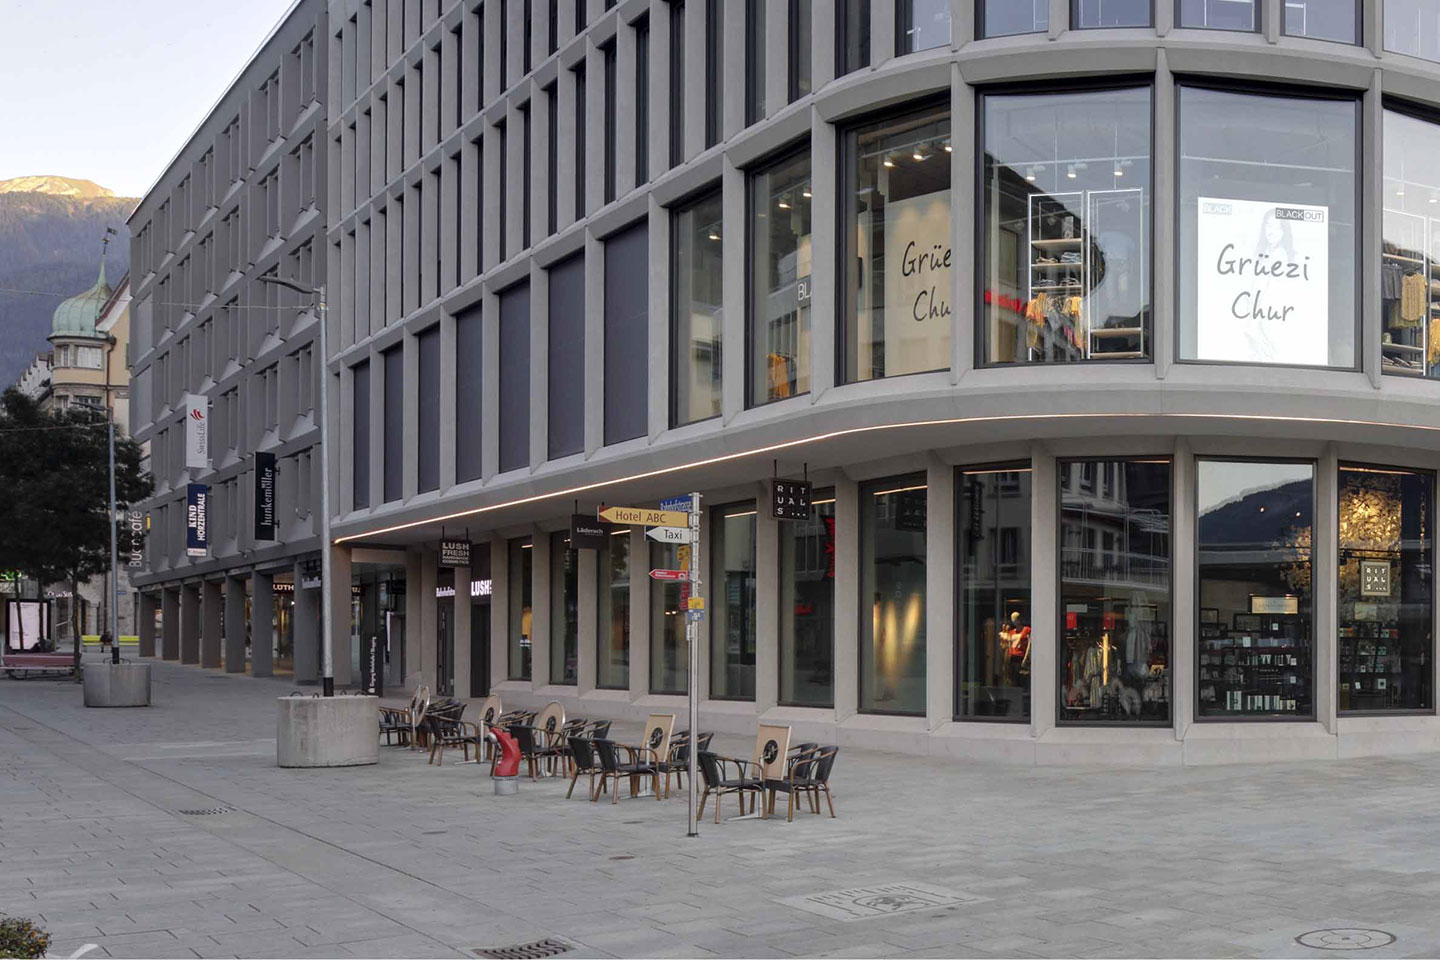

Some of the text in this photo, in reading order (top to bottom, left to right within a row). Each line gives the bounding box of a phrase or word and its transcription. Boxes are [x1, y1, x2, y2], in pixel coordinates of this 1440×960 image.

[1216, 243, 1310, 281] Grüezi
[798, 282, 812, 300] BL
[1232, 290, 1294, 322] Chur
[260, 468, 272, 526] hunkemöller
[188, 504, 197, 528] KIND
[616, 511, 666, 523] Hotel ABC
[664, 530, 682, 540] Taxi
[442, 542, 470, 550] LUSH
